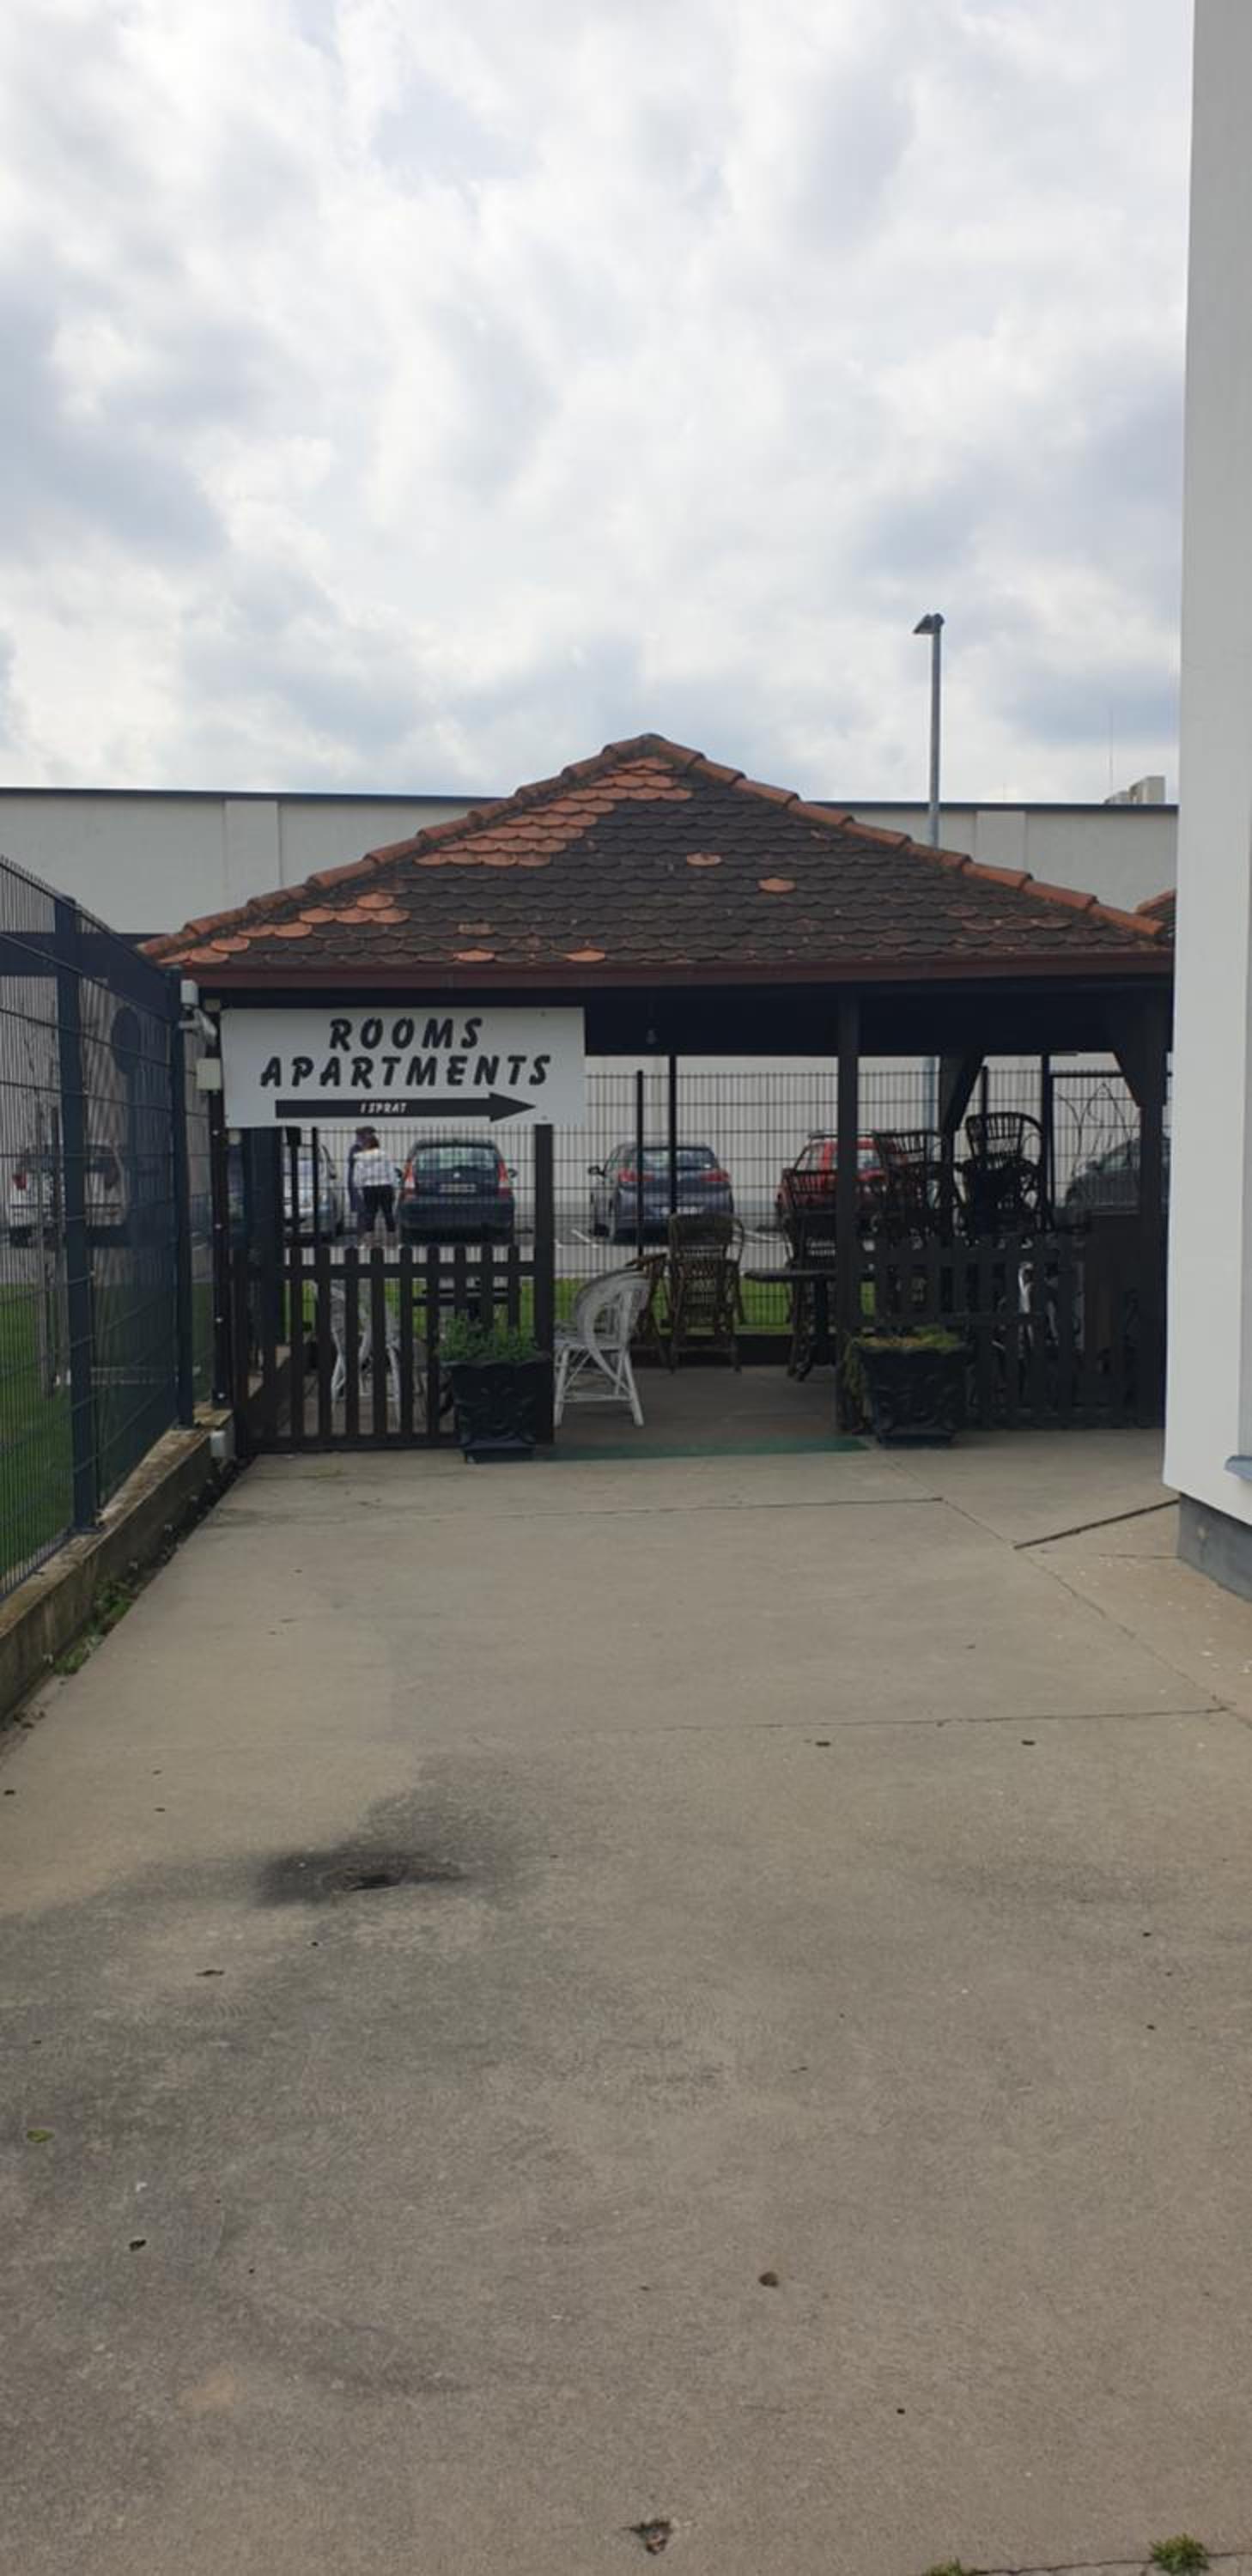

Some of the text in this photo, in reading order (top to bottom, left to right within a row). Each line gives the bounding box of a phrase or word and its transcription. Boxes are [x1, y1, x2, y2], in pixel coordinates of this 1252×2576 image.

[329, 1018, 483, 1052] ROOMS
[259, 1054, 552, 1090] APARTMENTS
[368, 1102, 407, 1114] SPRAT
